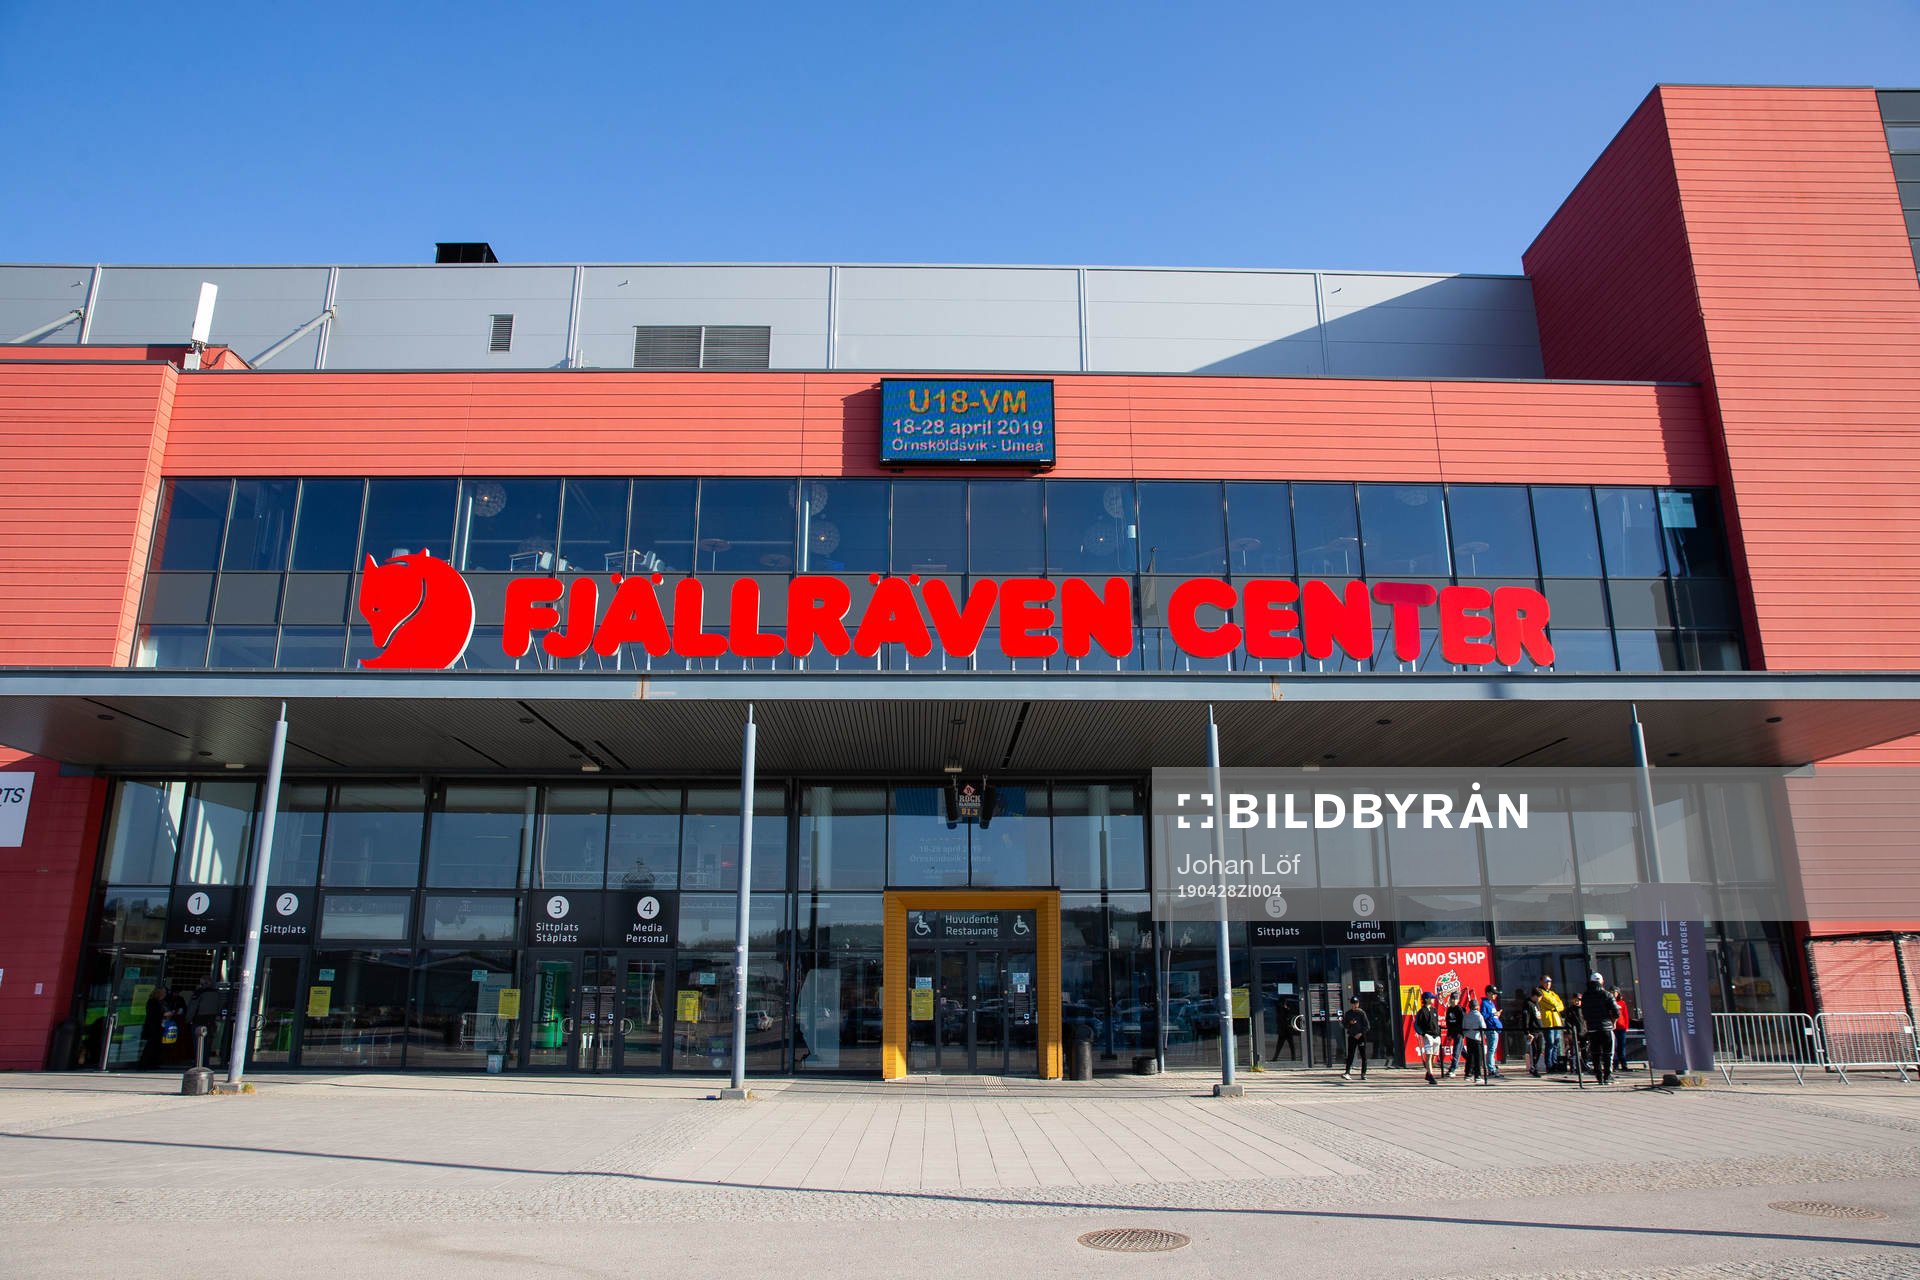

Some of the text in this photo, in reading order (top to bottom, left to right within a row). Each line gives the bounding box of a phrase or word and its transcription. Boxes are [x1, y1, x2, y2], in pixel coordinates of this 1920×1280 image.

[909, 389, 1026, 413] U18-VM
[892, 419, 1043, 438] 18-28 april 2019
[502, 573, 1555, 667] FJÄLLRÄVEN CENTER
[0, 787, 25, 803] TS
[945, 914, 999, 924] Huvudentré
[183, 924, 207, 934] Loge
[263, 925, 307, 935] Sittplats
[535, 922, 579, 933] Sittplats
[633, 923, 663, 932] Media
[1350, 920, 1381, 930] Familj
[945, 926, 999, 938] Restaurang
[1257, 927, 1300, 938] Sittplats
[1346, 931, 1386, 942] Ungdom
[536, 933, 578, 944] Ståplats
[626, 934, 669, 943] Personal
[1405, 951, 1486, 966] MODO SHOP
[1657, 940, 1672, 989] BEIJER
[1682, 957, 1691, 976] SOM
[1685, 1000, 1696, 1035] BYGGER
